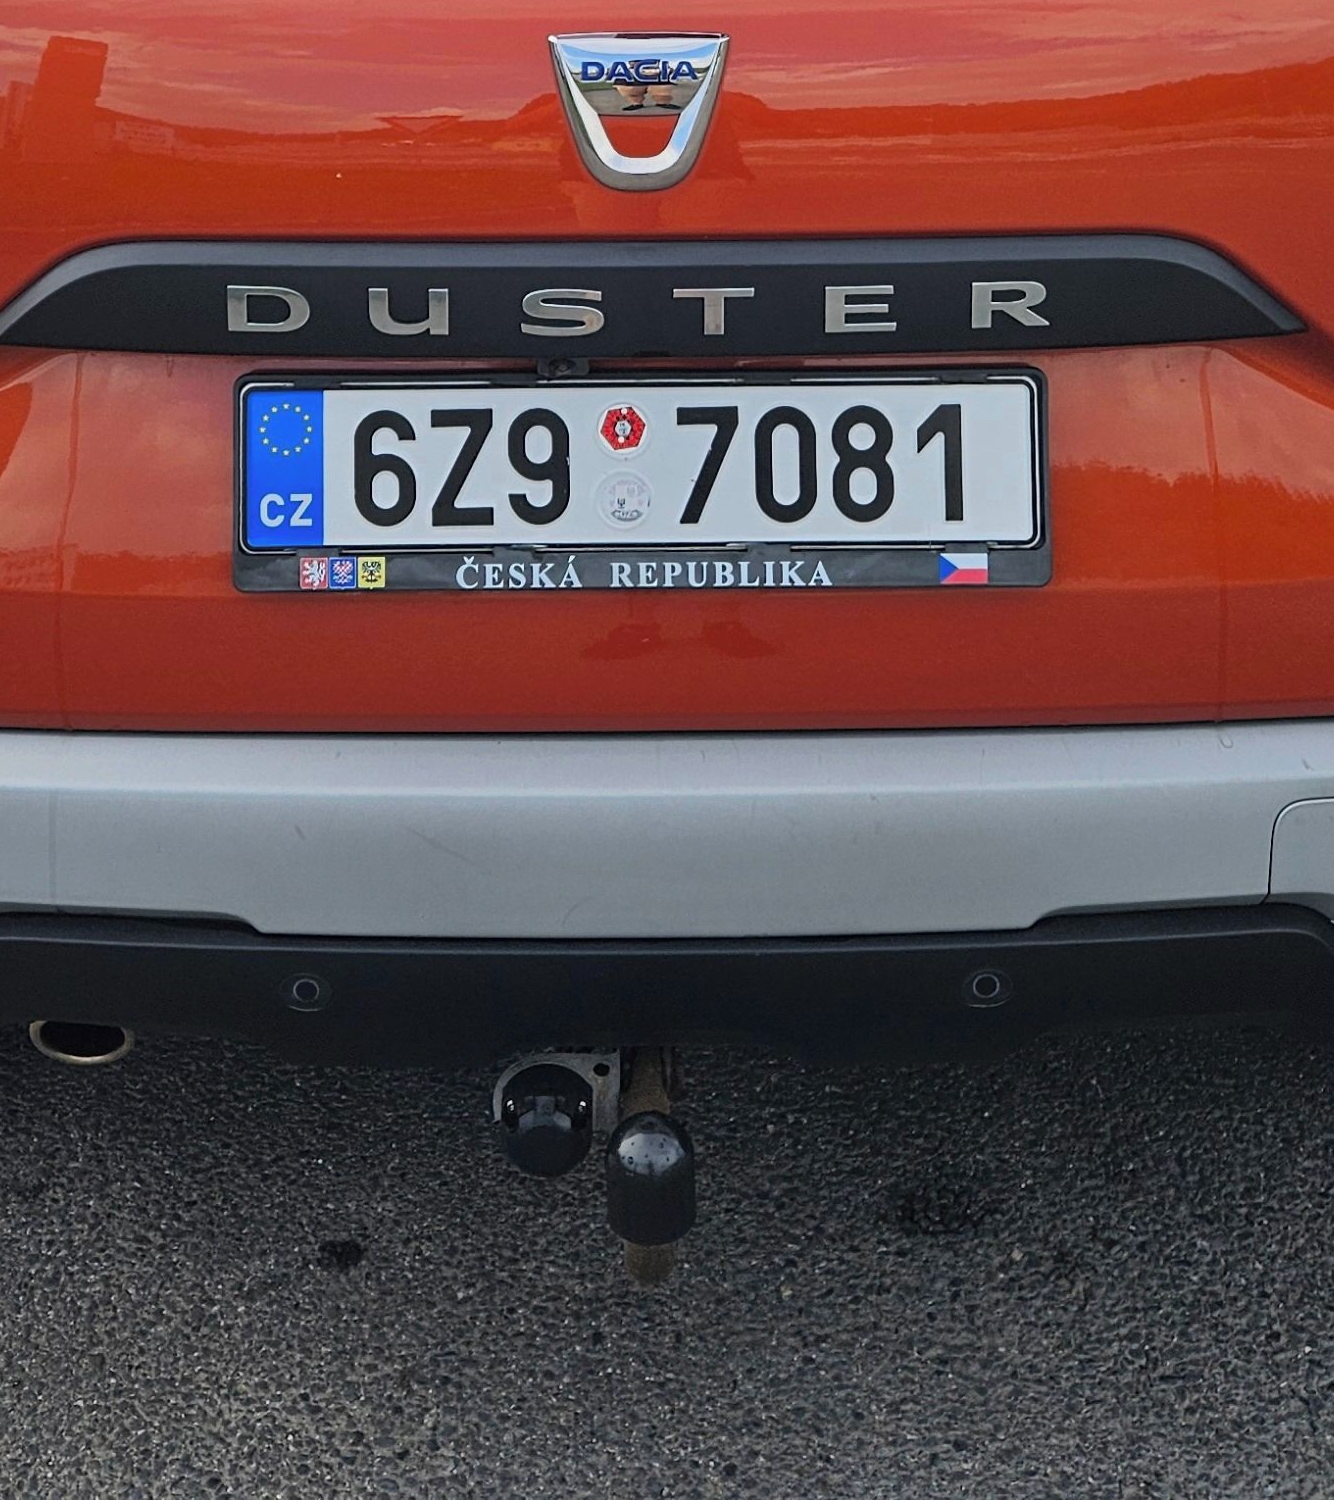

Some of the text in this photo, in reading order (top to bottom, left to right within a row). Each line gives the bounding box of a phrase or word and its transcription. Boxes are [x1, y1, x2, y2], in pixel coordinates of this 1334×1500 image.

[580, 58, 699, 81] DACIA
[227, 280, 1051, 338] DUSTER
[353, 404, 964, 527] 6Z9 7081
[259, 493, 313, 527] CZ
[455, 555, 833, 588] ČESKÁ REPUBLIKA
